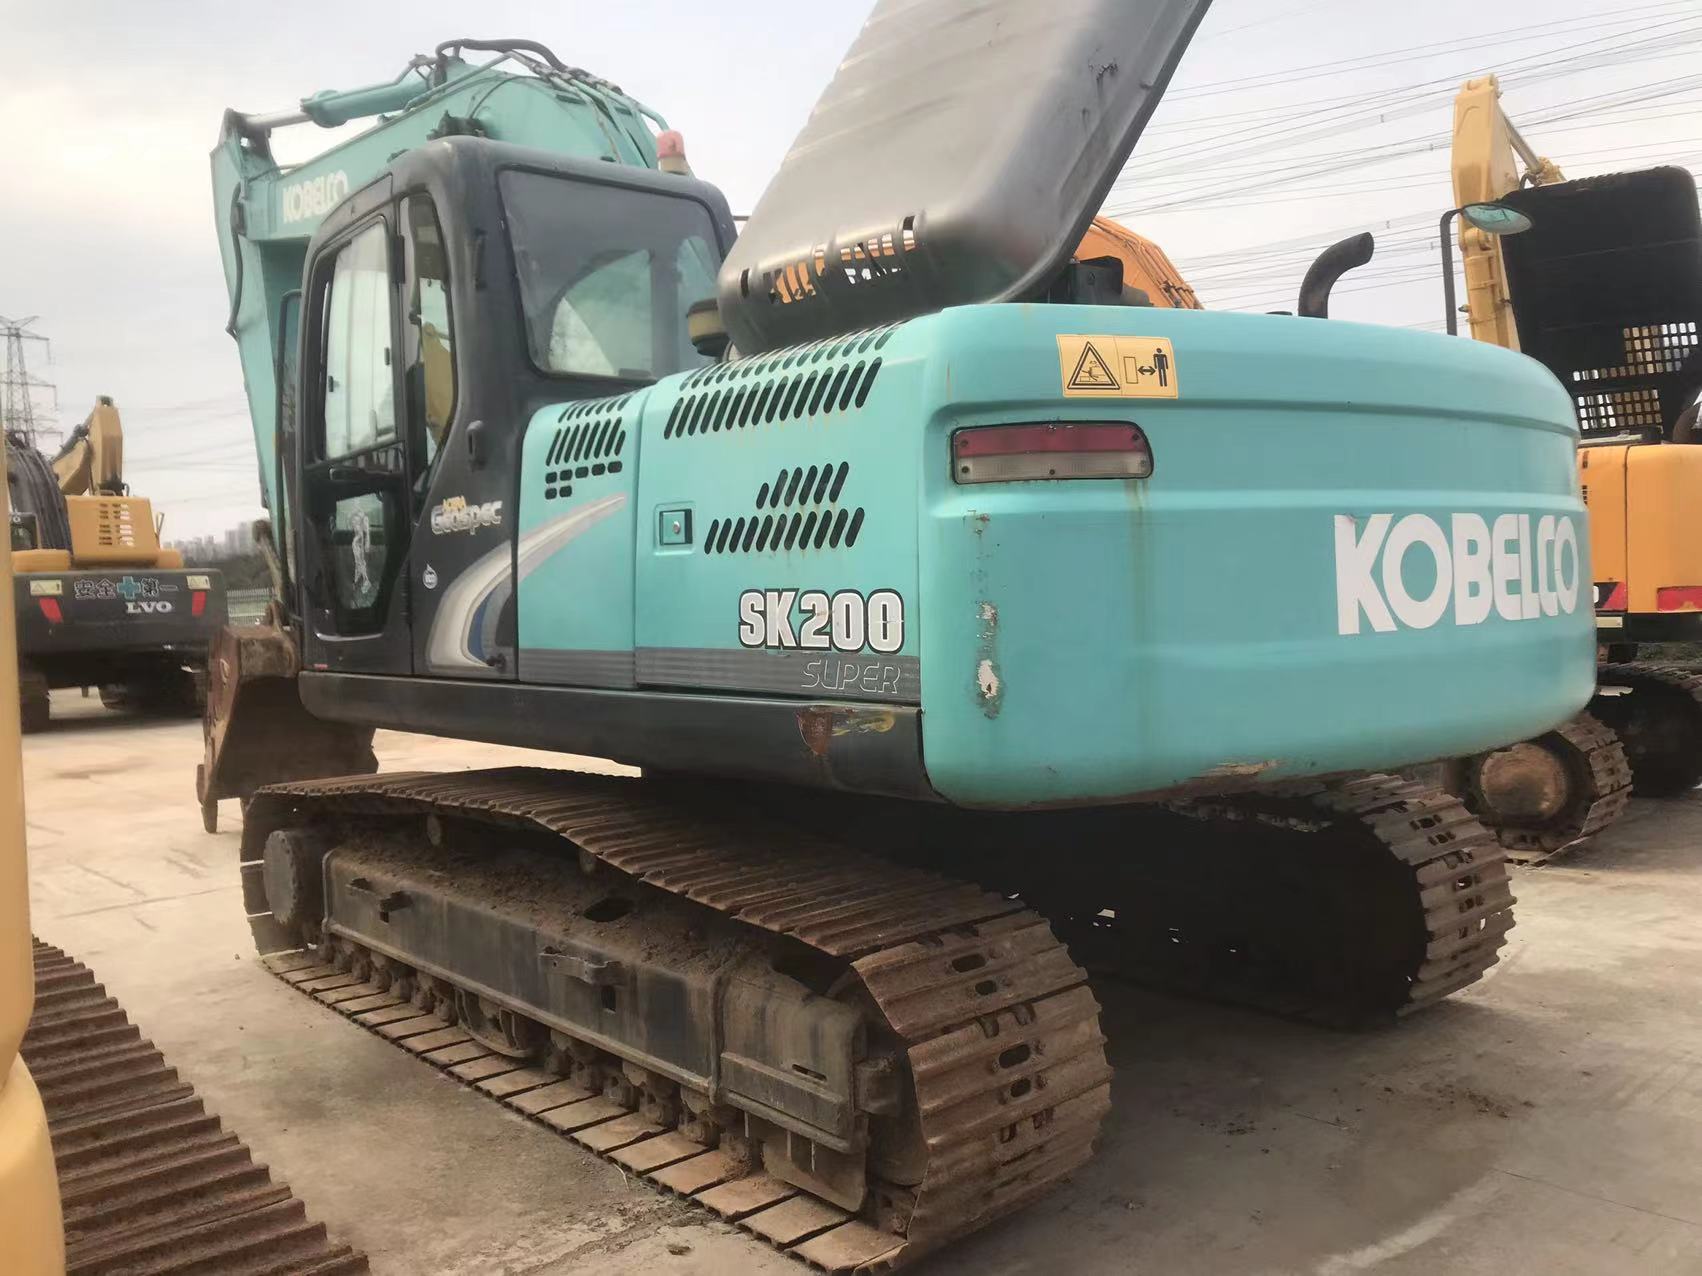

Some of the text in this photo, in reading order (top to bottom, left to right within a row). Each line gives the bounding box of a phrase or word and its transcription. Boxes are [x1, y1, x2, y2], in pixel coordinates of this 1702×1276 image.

[1334, 513, 1579, 635] KOBELCO
[739, 589, 904, 654] SK200
[801, 660, 901, 694] SUPER
